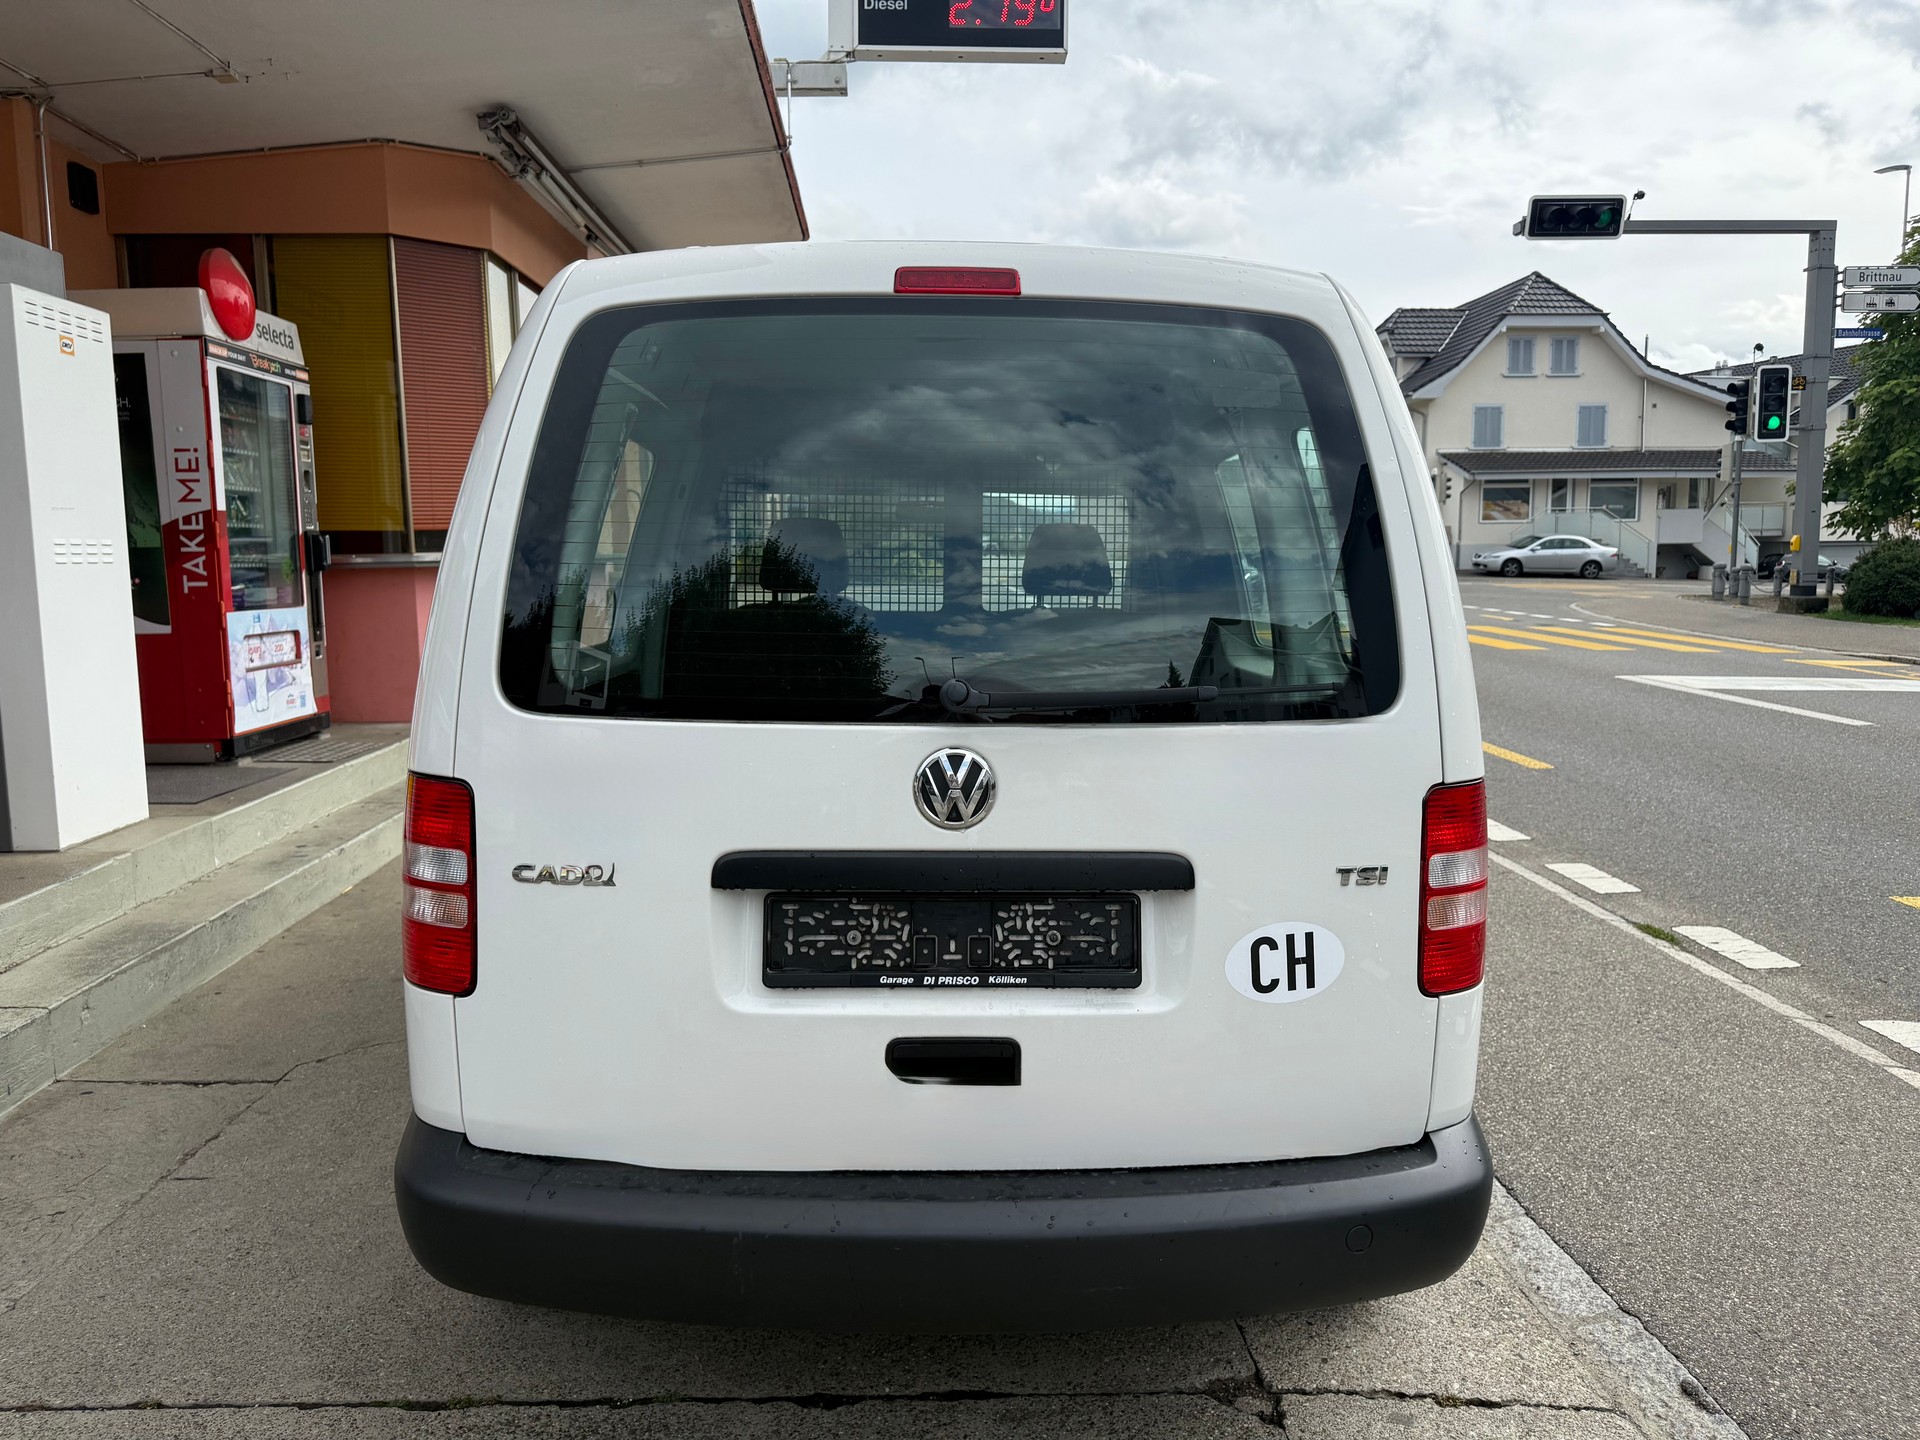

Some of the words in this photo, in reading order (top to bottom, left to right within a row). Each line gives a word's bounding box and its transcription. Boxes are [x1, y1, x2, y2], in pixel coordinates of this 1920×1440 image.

[864, 0, 908, 10] Diesel
[1859, 271, 1902, 283] Brittnau
[255, 322, 295, 350] selecta
[1838, 329, 1881, 337] Bahnhofstrasse
[173, 447, 202, 503] ME!
[178, 513, 209, 594] TAKE
[1335, 865, 1389, 887] TSI
[1250, 931, 1316, 994] CH
[879, 975, 914, 985] Garage
[923, 976, 935, 985] DI
[938, 976, 980, 985] PRISCO
[988, 975, 1028, 984] Kölliken
